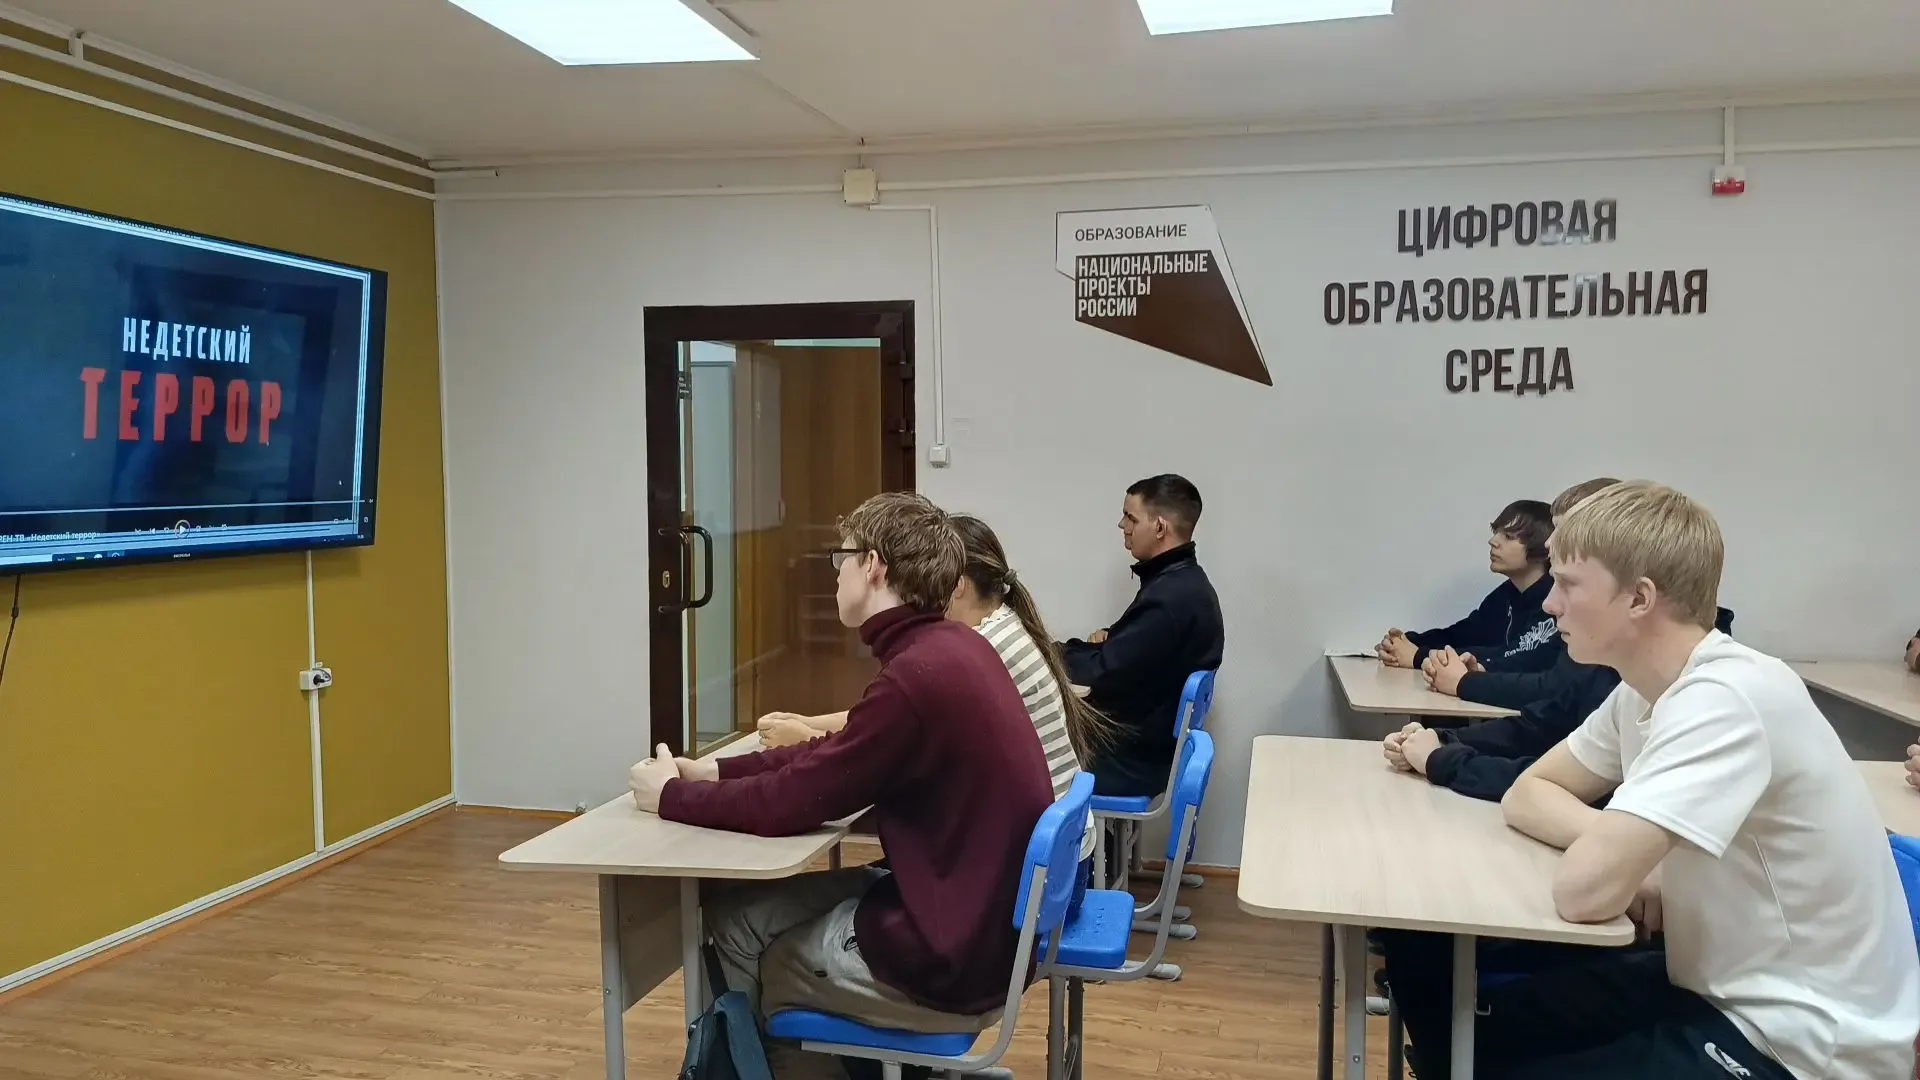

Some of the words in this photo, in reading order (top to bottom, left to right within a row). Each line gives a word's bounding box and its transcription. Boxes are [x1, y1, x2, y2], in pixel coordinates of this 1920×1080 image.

[1075, 224, 1187, 241] ОБРАЗОВАНИЕ
[1398, 199, 1617, 257] ЦИФРОВАЯ
[1078, 253, 1208, 278] НАЦИОНАЛЬНЫЕ
[1078, 275, 1151, 297] ПРОЕКТЫ
[1078, 297, 1137, 317] РОССИИ
[1323, 268, 1708, 325] ОБРАЗОВАТЕЛЬНАЯ
[122, 317, 251, 363] НЕДЕТСКИЙ
[1445, 347, 1574, 395] СРЕДА
[80, 367, 282, 443] ТЕРРОР
